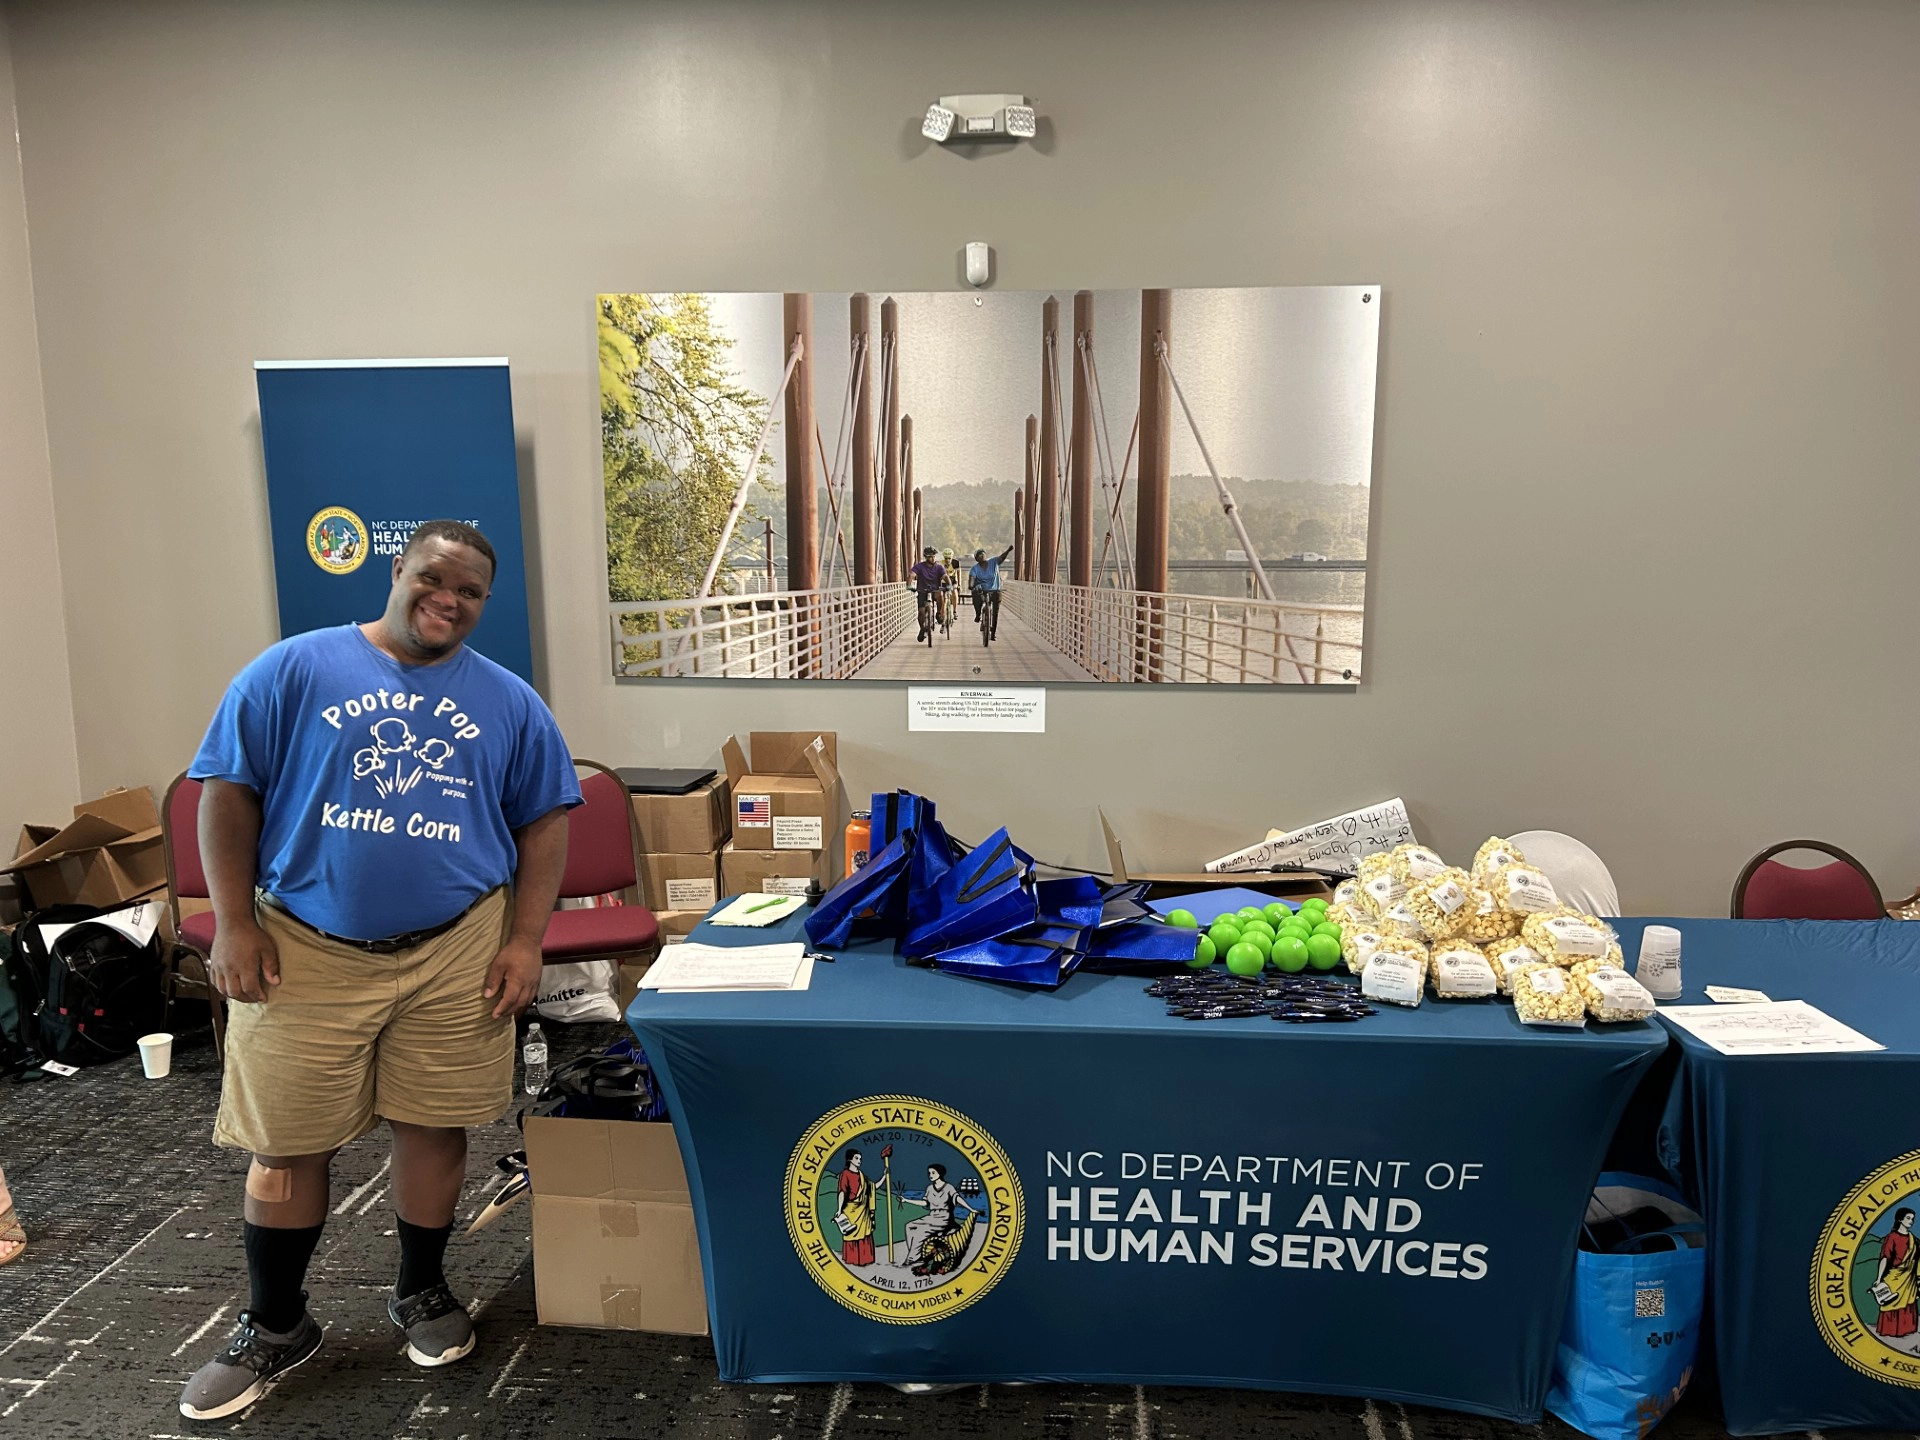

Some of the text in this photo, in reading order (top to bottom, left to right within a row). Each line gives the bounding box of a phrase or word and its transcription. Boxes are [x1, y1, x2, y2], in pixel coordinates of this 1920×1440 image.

[371, 521, 387, 530] NC
[347, 515, 362, 531] NORTH
[356, 531, 366, 560] CAROLINA
[373, 531, 414, 543] HEAL
[374, 544, 403, 555] HUM
[321, 688, 481, 740] Pooter Pop
[425, 771, 454, 784] Popping
[455, 777, 467, 785] with
[321, 802, 461, 843] Kettle Corn
[1359, 805, 1402, 829] With
[1314, 824, 1338, 838] very
[1367, 835, 1389, 848] the
[862, 1131, 934, 1147] MAY 20, 1775
[1046, 1150, 1483, 1191] NC DEPARTMENT OF
[797, 1107, 1011, 1275] THE GREAT SEAL OF THE STATE OF NORTH CAROLINA
[1048, 1186, 1422, 1233] HEALTH AND
[1047, 1226, 1489, 1280] HUMAN SERVICES
[1826, 1167, 1920, 1347] THE GREAT SEAL OF TH
[869, 1275, 896, 1289] APRIL
[914, 1276, 934, 1289] 1776
[856, 1289, 952, 1311] ESSE QUAM VIDERI
[1893, 1360, 1918, 1375] ESSE
